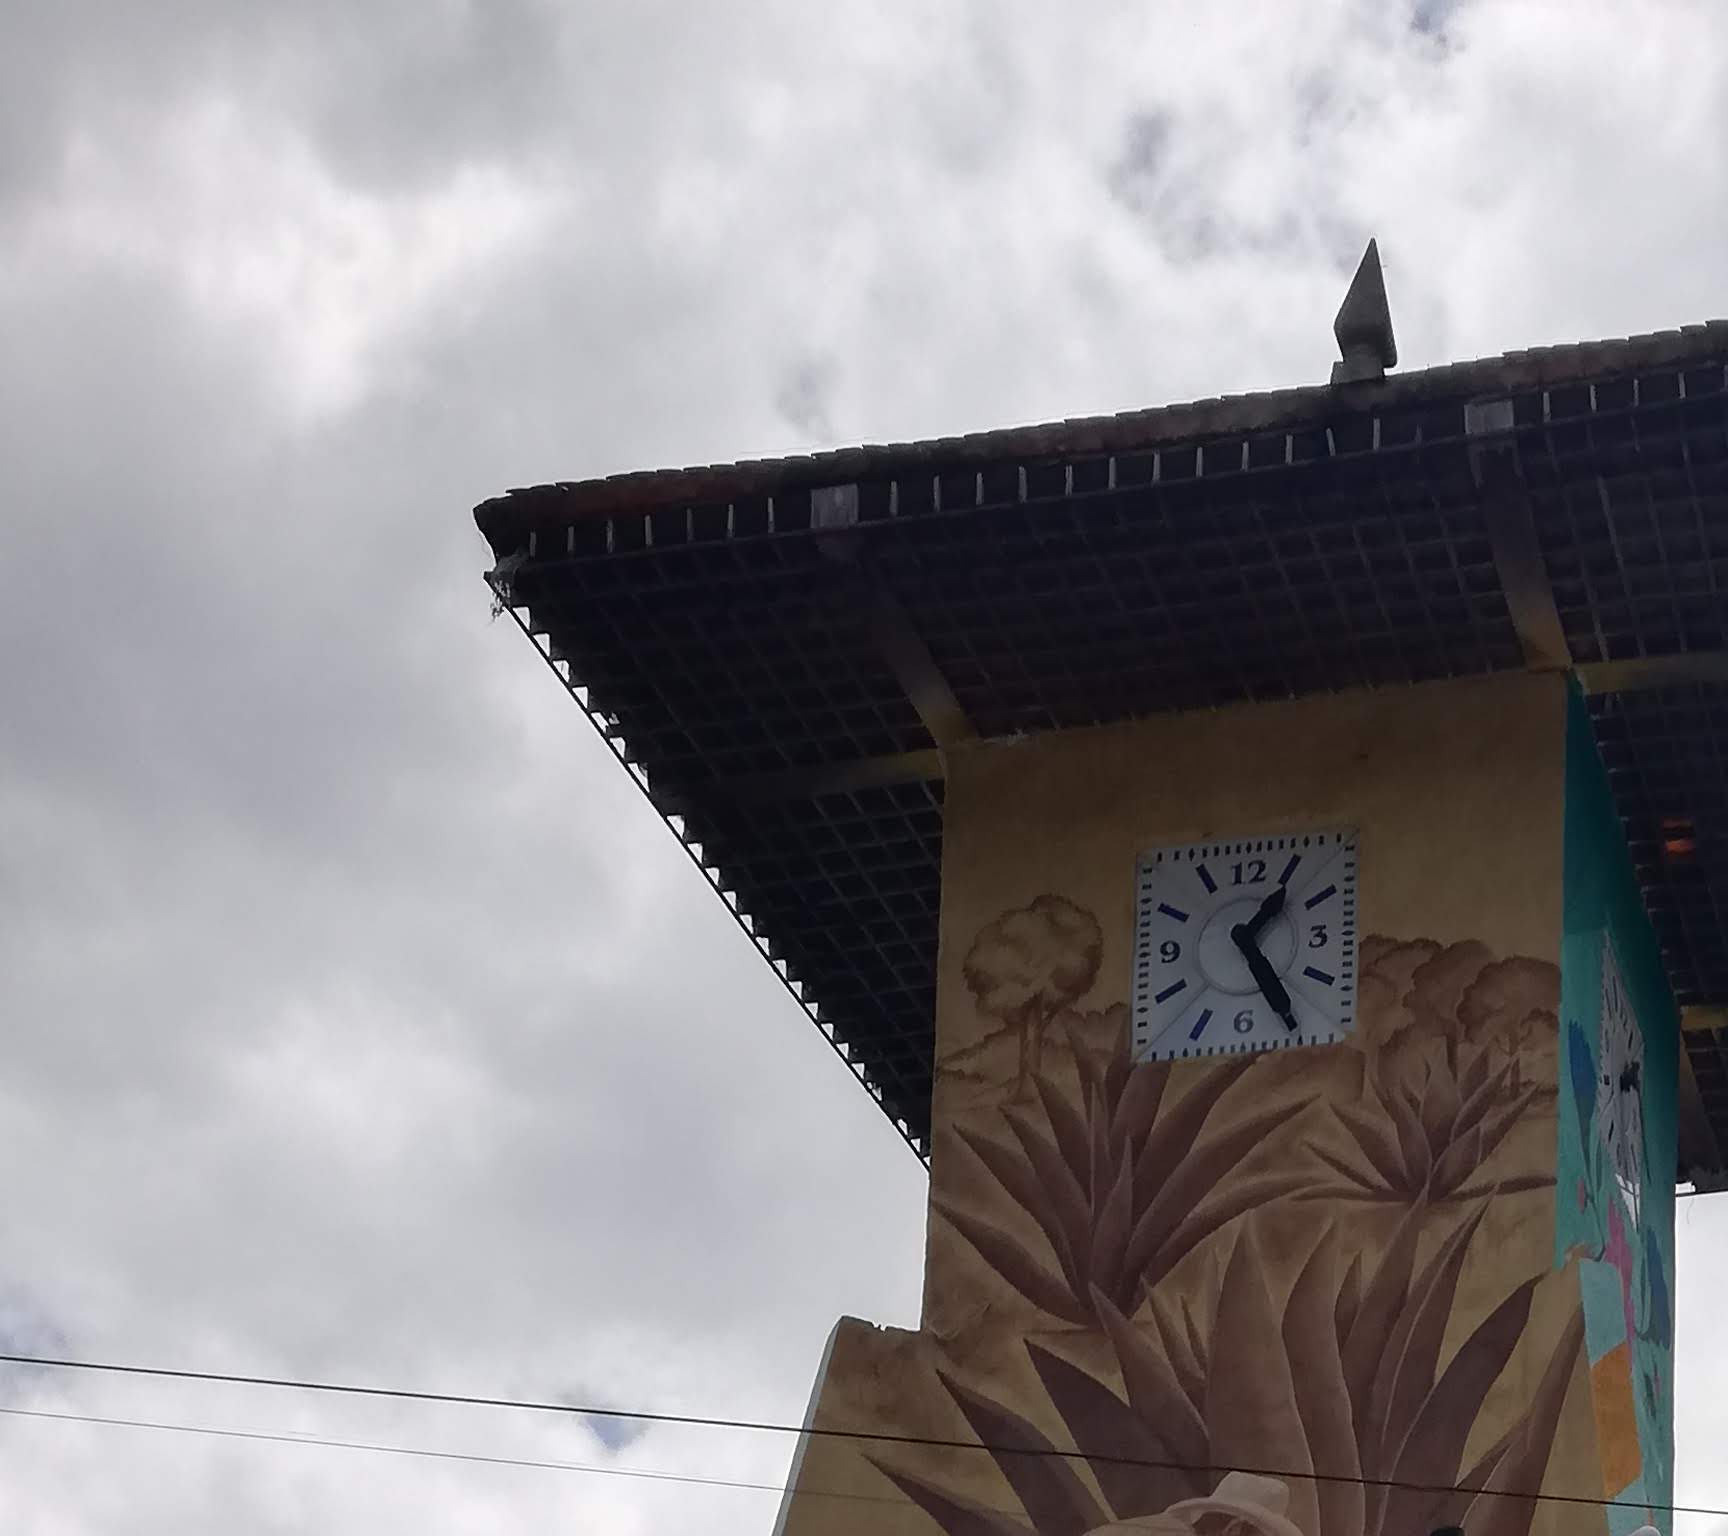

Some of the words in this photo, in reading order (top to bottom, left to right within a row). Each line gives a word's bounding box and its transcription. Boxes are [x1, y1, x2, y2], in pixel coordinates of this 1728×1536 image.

[1231, 860, 1266, 886] 12
[1309, 924, 1328, 948] 3
[1159, 940, 1181, 964] 9
[1233, 1010, 1254, 1034] 6
